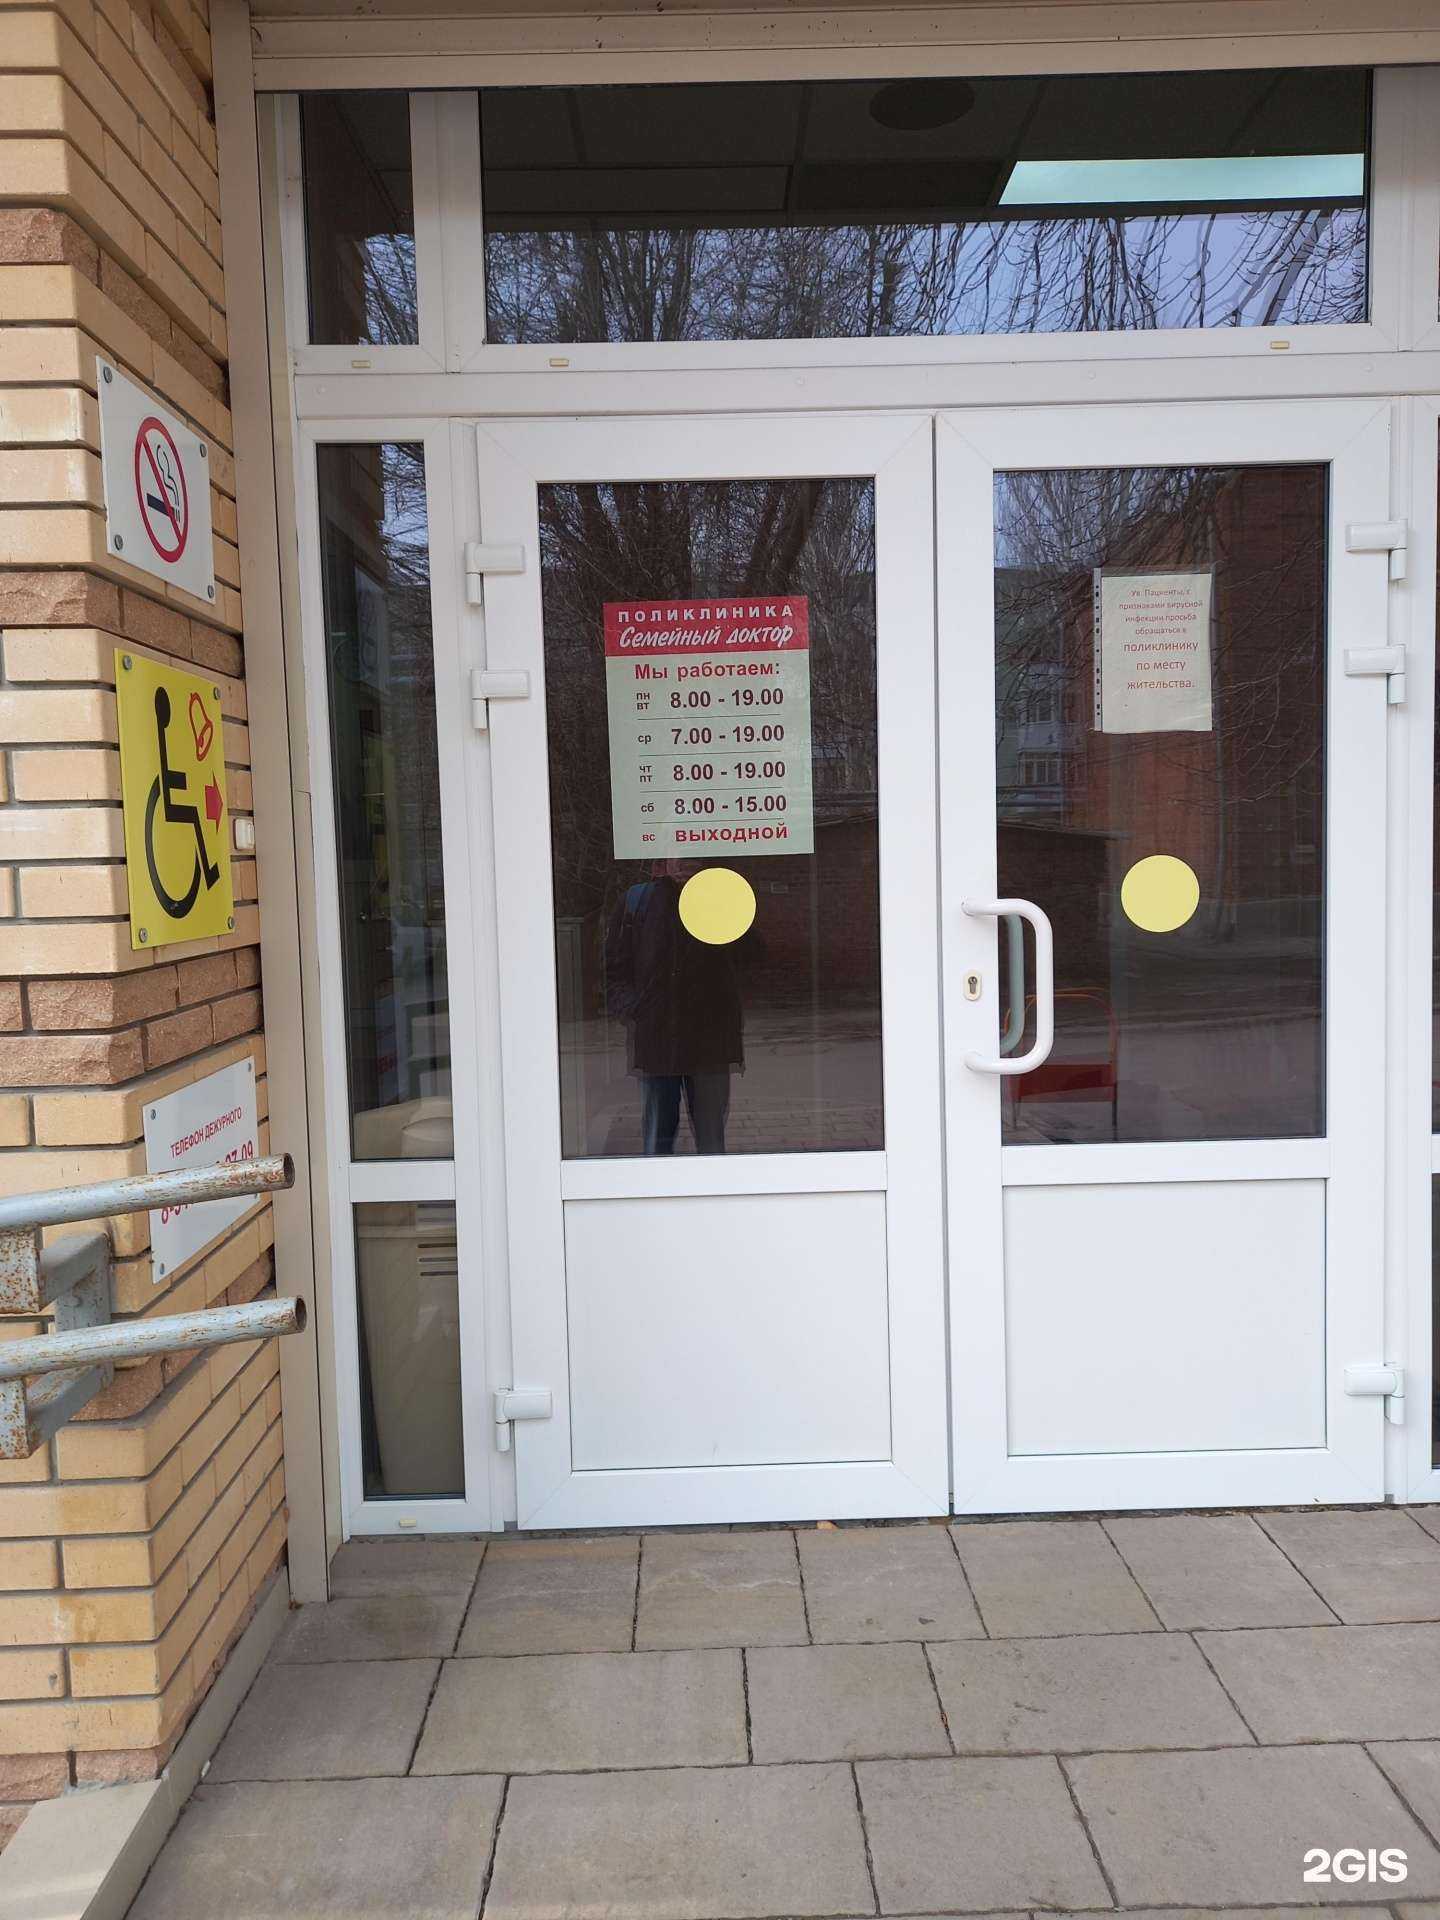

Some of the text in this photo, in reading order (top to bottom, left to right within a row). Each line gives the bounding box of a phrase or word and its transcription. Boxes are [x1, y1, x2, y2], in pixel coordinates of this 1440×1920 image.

[618, 604, 793, 623] ПОЛИКЛИНИКА
[1166, 613, 1197, 622] просьба
[619, 625, 721, 648] Семейный
[1124, 641, 1199, 652] поликлинику
[635, 662, 781, 682] Мы работаем:
[1136, 660, 1186, 671] по месту
[1127, 679, 1196, 690] жительства.
[636, 692, 650, 701] пн
[636, 702, 650, 710] вт
[670, 691, 711, 709] 8.00
[732, 688, 784, 706] 19.00
[638, 735, 652, 745] ср
[671, 727, 712, 745] 7.00
[732, 725, 785, 743] 19.00
[639, 765, 652, 773] чт
[639, 774, 652, 783] пт
[673, 764, 714, 781] 8.00
[734, 761, 786, 779] 19.00
[641, 802, 655, 813] сб
[674, 797, 715, 814] 8.00
[735, 795, 787, 813] 15.00
[642, 822, 788, 843] вс ВЫХОДНОЙ
[170, 1106, 242, 1158] ТЕЛЕФОН ДЕЖУРНОГО
